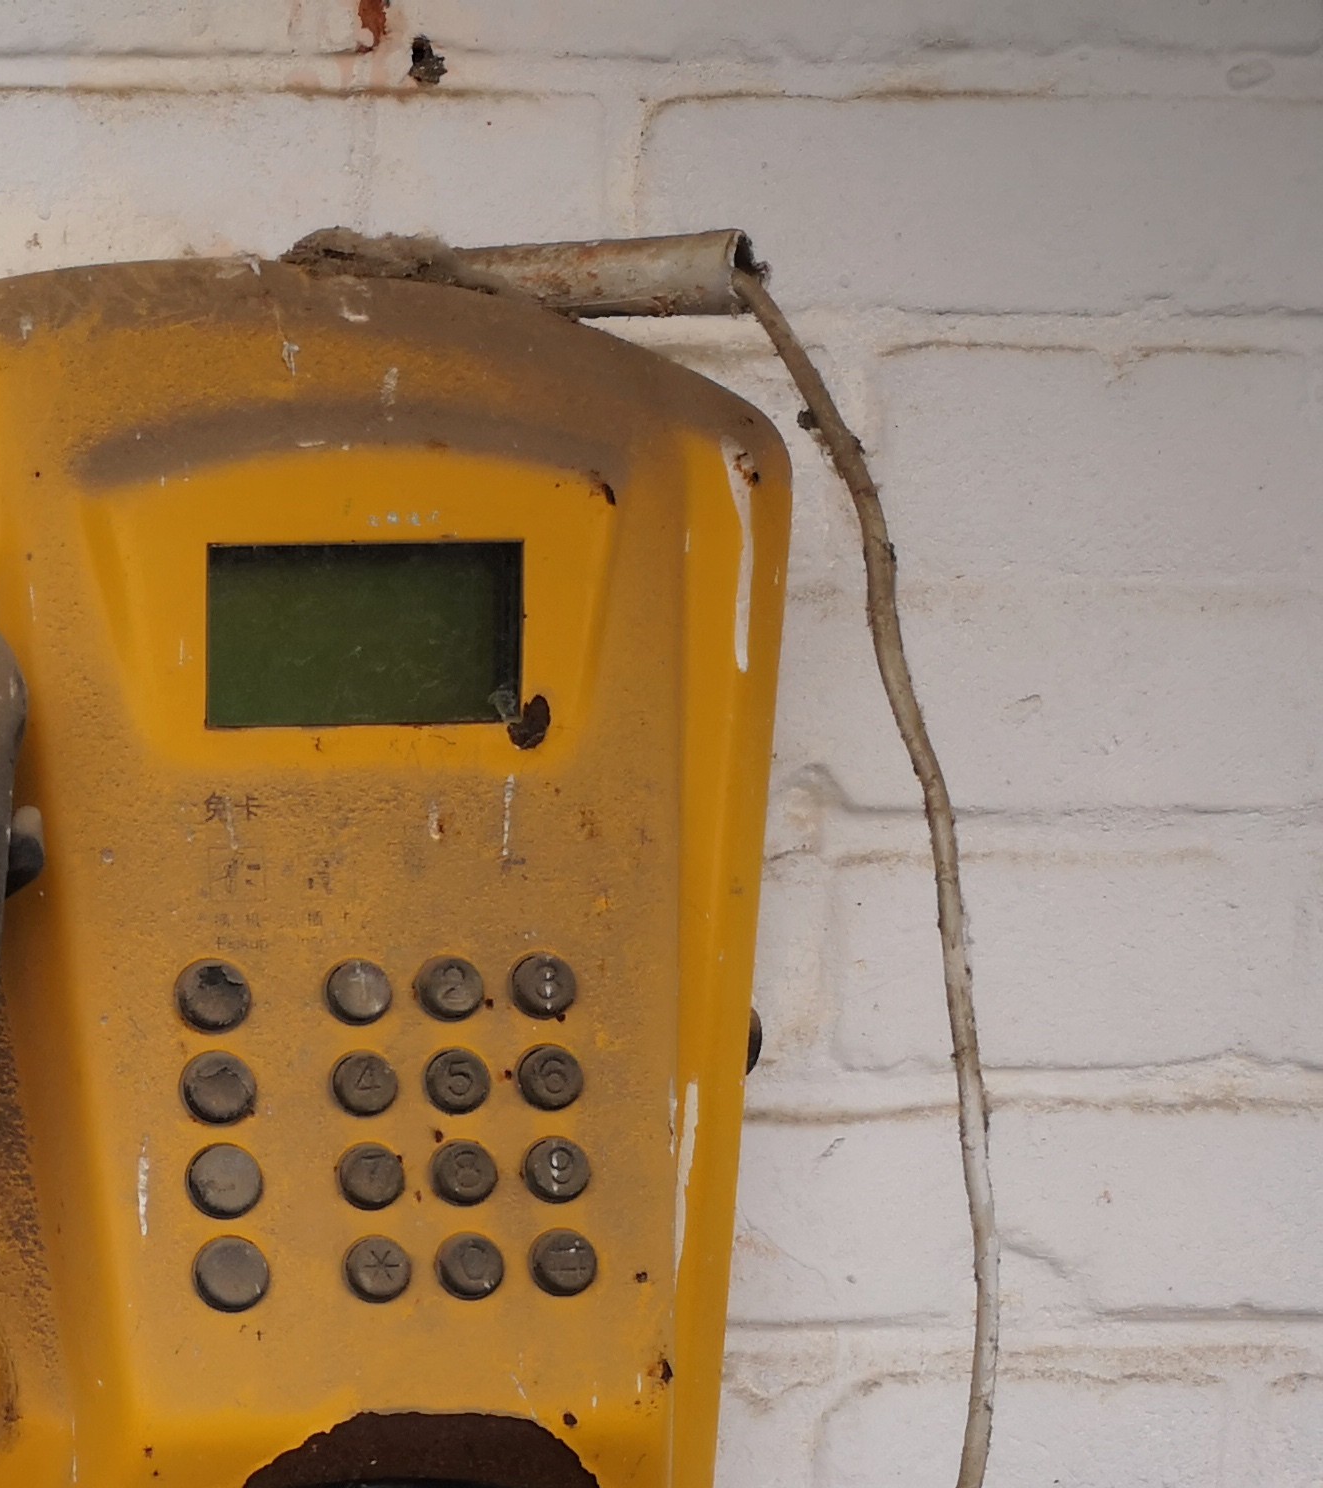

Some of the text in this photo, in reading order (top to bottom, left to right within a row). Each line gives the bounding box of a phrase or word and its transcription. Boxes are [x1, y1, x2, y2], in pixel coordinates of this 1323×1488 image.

[441, 966, 467, 1002] 2
[356, 1055, 570, 1096] 4 5 6
[360, 1146, 576, 1189] 7 8 9
[459, 1244, 488, 1282] 0
